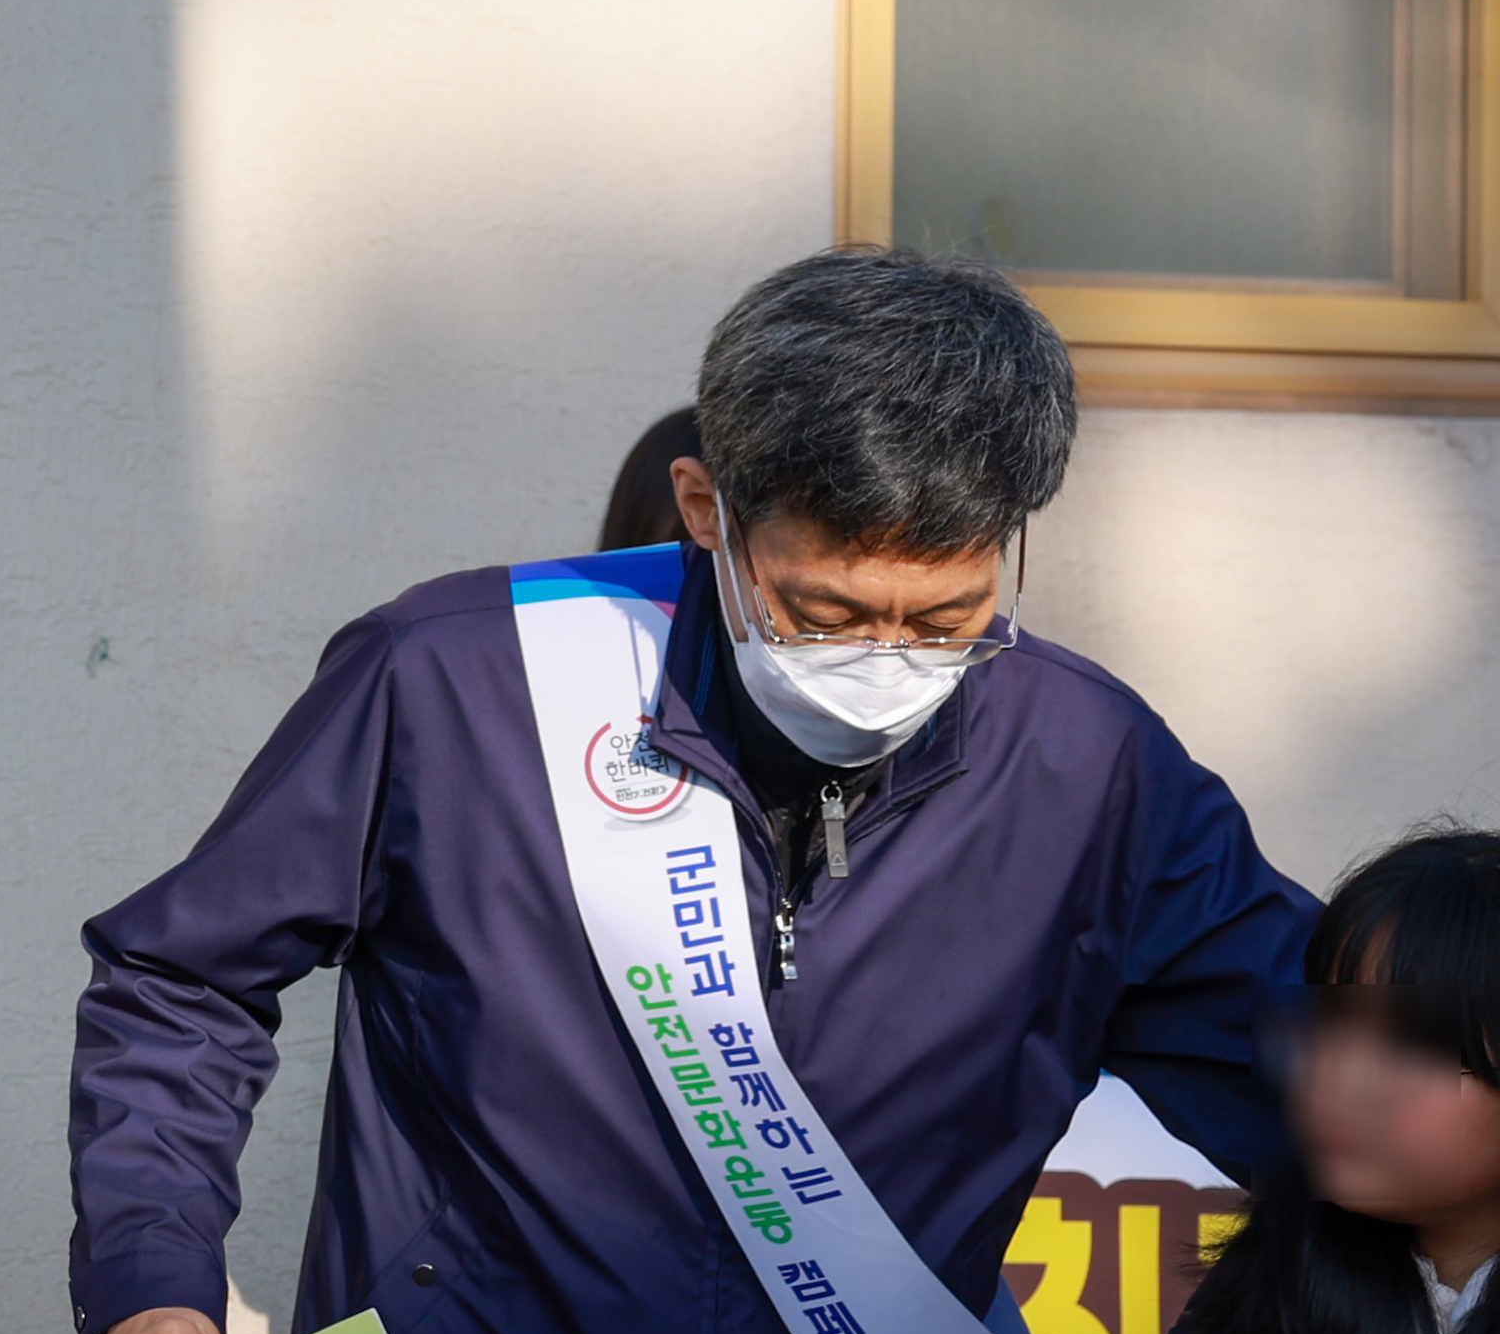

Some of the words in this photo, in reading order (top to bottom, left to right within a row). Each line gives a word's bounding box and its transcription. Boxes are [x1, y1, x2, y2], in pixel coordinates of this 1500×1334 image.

[604, 754, 670, 784] 한바퀴
[626, 963, 795, 1246] 안전문화운동
[665, 845, 738, 1000] 군민과
[708, 1021, 843, 1206] 함께하는
